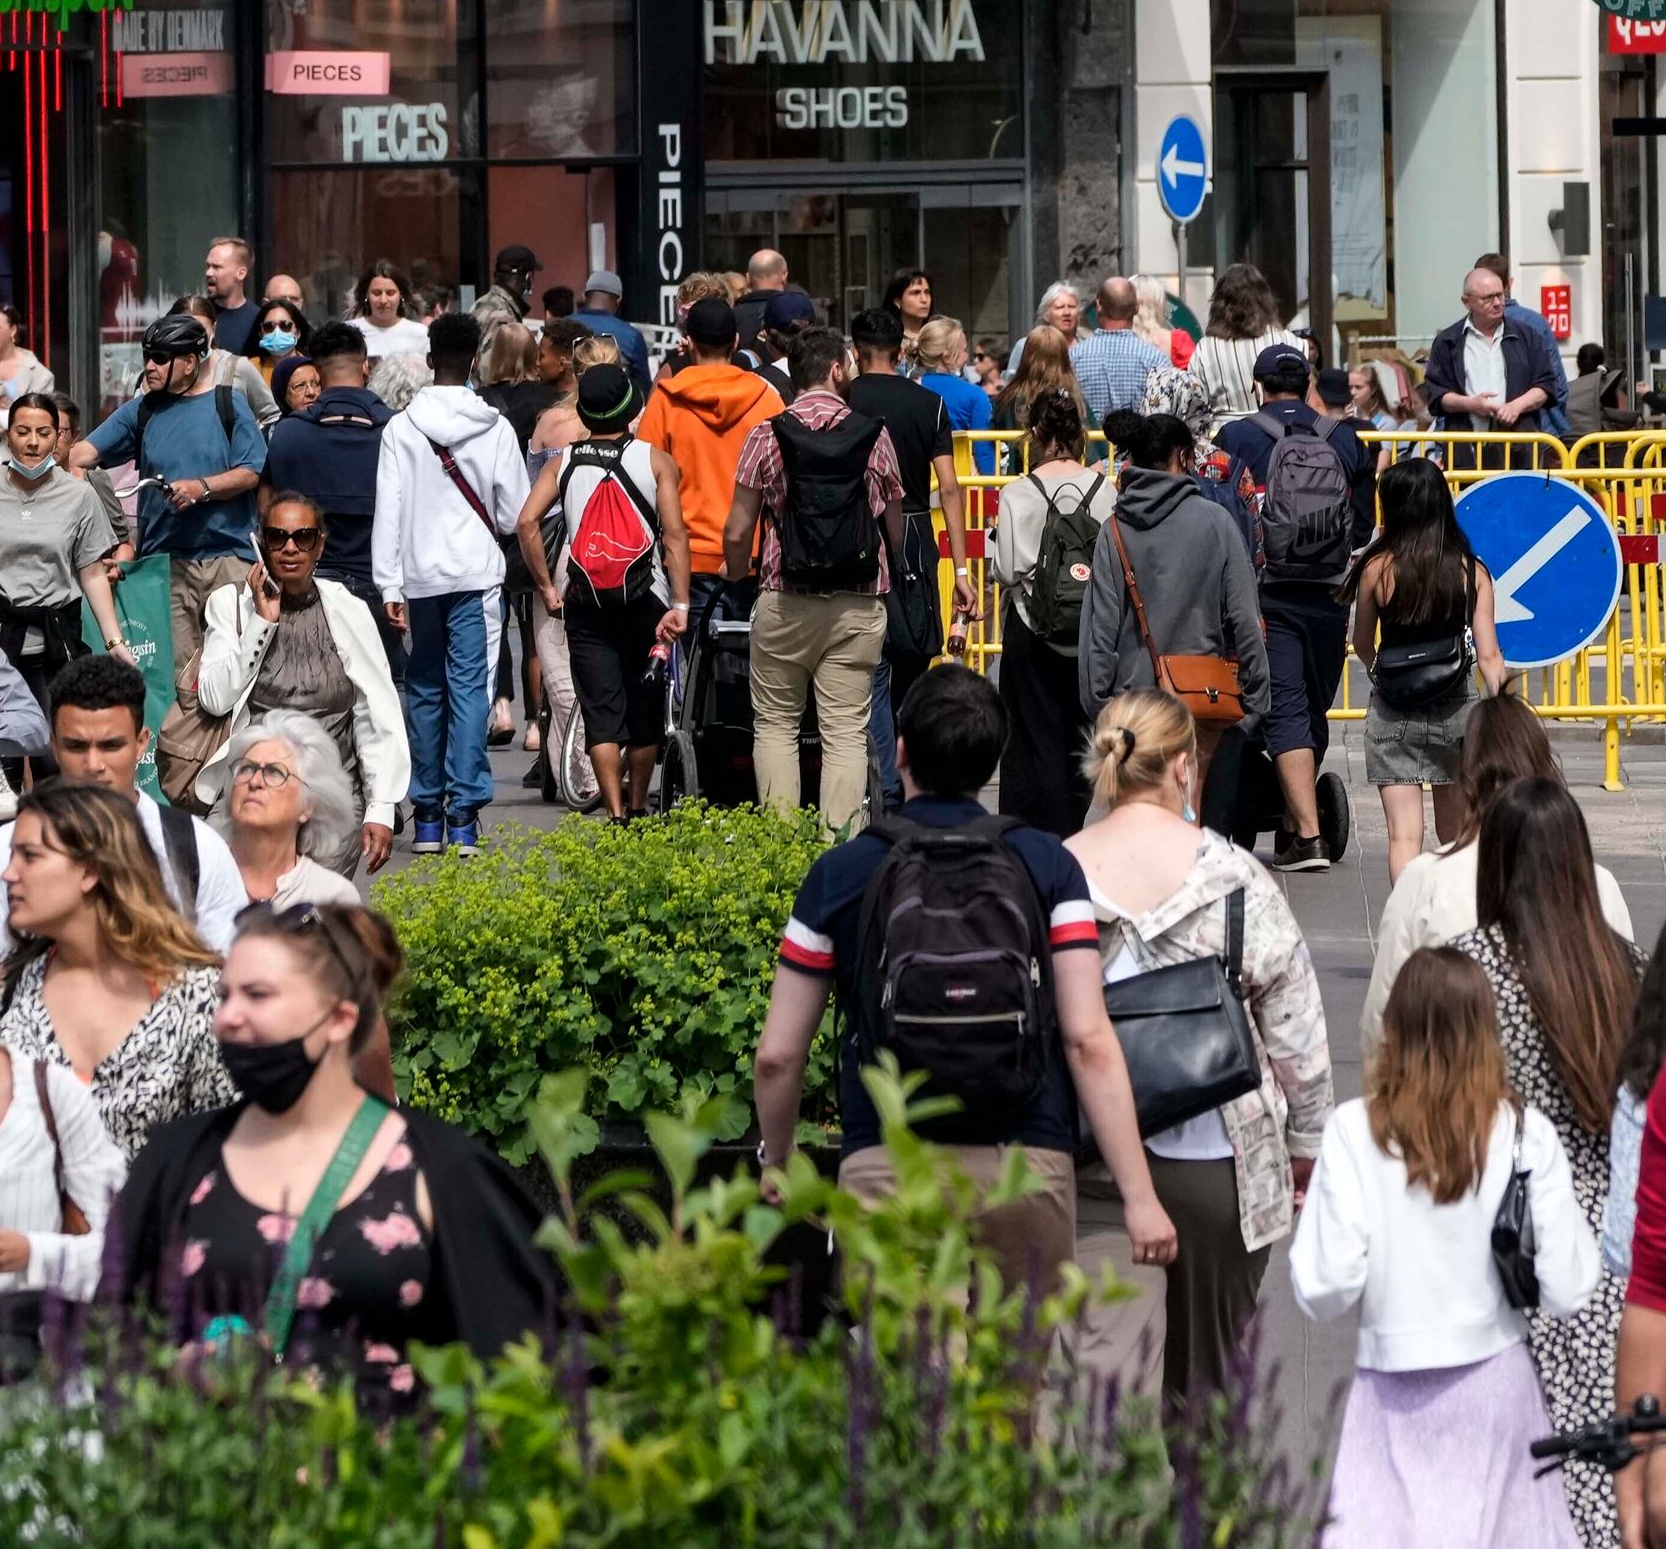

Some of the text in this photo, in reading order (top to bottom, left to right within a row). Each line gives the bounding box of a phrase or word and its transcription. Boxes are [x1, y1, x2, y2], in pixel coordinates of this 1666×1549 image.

[293, 64, 362, 82] PIECES
[776, 84, 909, 130] SHOES
[342, 102, 449, 163] PIECES
[658, 123, 683, 332] PIECE
[574, 444, 619, 459] ellesse
